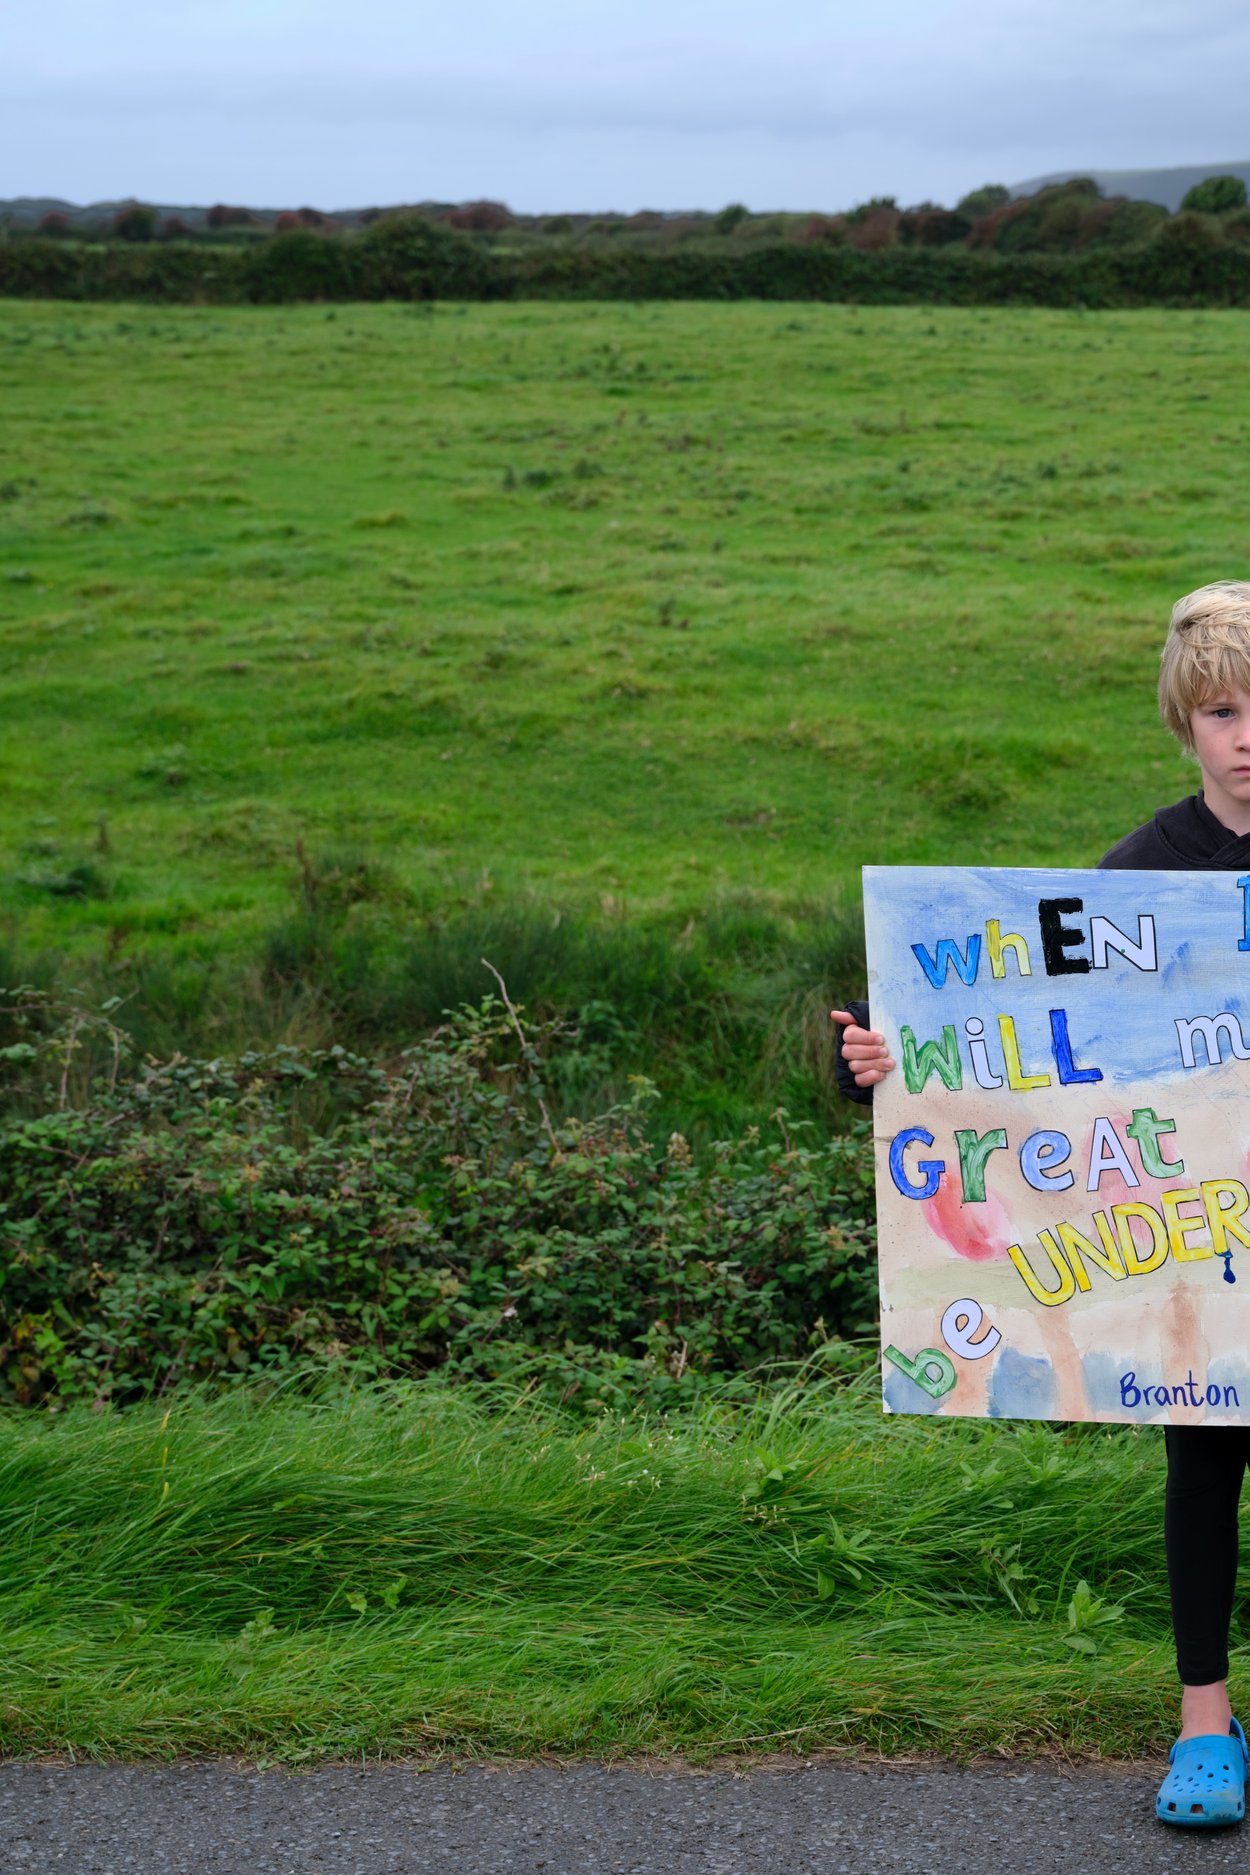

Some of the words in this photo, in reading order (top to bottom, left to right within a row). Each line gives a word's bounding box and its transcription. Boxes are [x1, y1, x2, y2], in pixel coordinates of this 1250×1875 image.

[889, 1107, 1184, 1203] GreAt
[883, 1297, 1002, 1399] be
[1119, 1370, 1241, 1408] Branton
